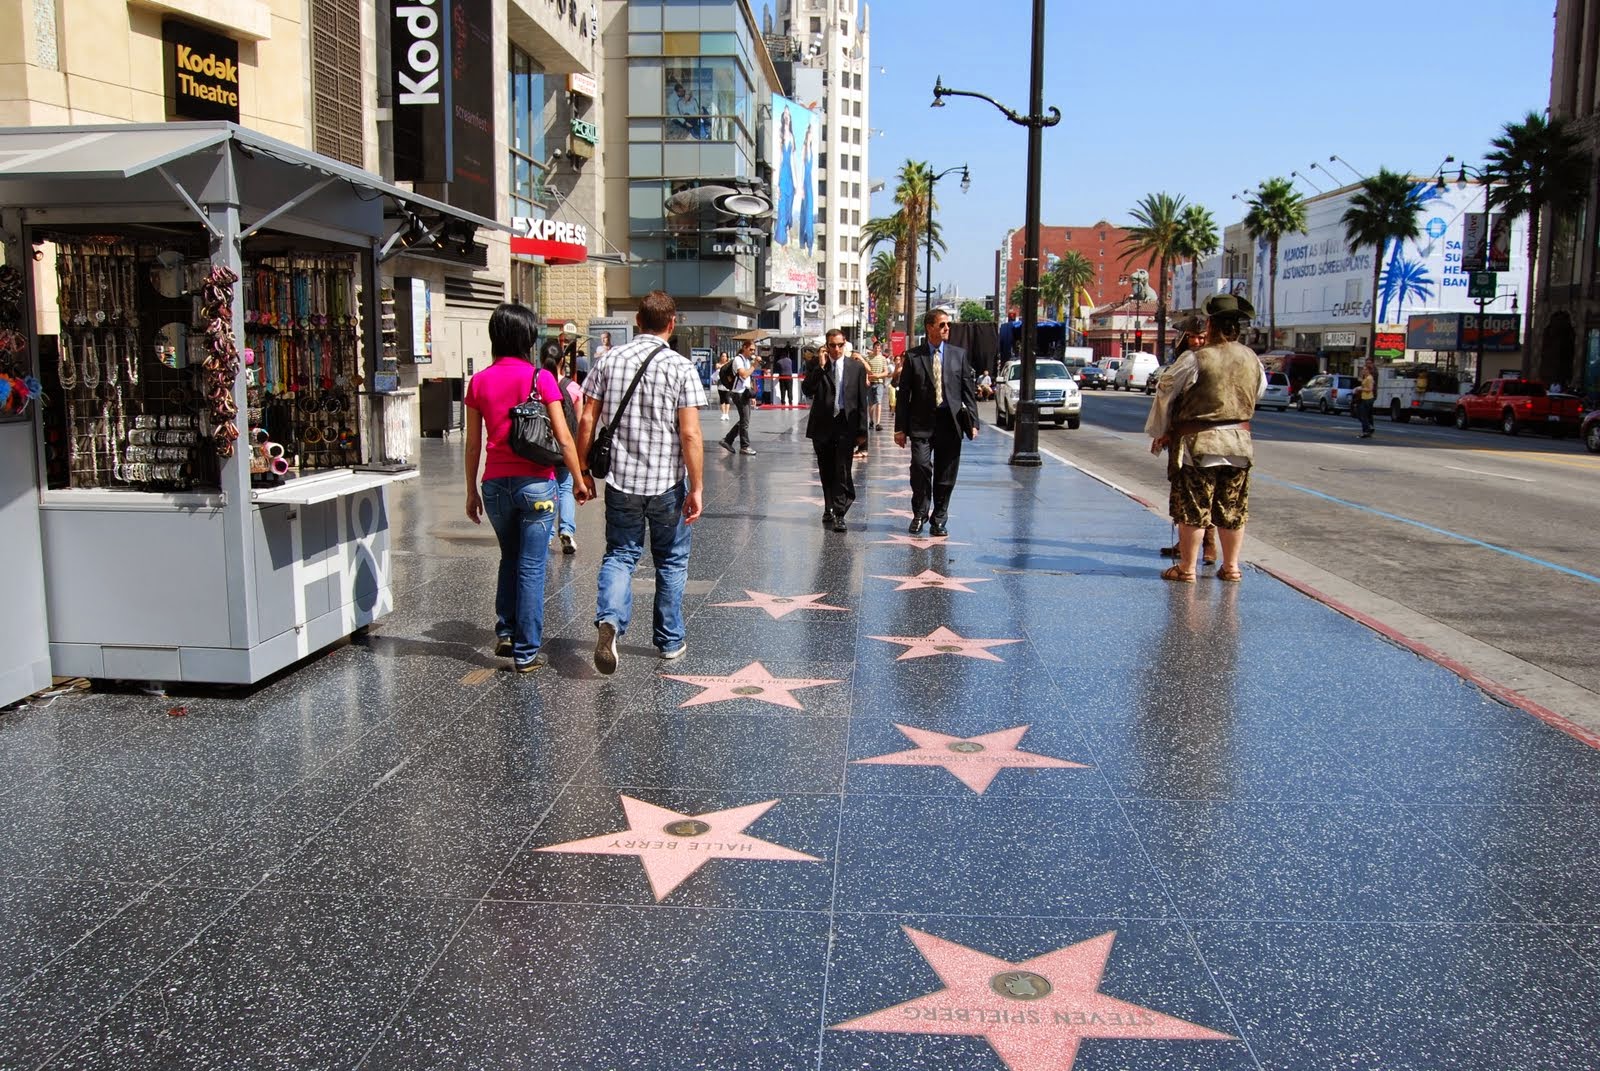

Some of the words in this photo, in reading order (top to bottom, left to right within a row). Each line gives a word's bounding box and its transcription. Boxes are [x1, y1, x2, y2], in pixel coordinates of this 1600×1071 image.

[396, 0, 439, 104] Kod
[176, 44, 238, 84] Kodak
[177, 73, 238, 107] Theatre
[512, 216, 587, 247] EXPRESS
[1283, 244, 1308, 262] ALMOST
[1309, 244, 1318, 257] AS
[1282, 266, 1292, 280] AS
[1292, 263, 1317, 279] UNSOLD
[1442, 278, 1468, 287] BAN
[1331, 301, 1363, 317] CHASE
[1432, 318, 1458, 336] Budget
[1377, 332, 1403, 342] Public
[1375, 340, 1405, 351] Parking
[688, 677, 753, 685] CHARLIZE
[608, 838, 678, 851] BERRY
[688, 840, 753, 852] HALLE
[902, 1005, 1041, 1025] SPIELBERG
[1054, 1011, 1155, 1027] STEVEN
